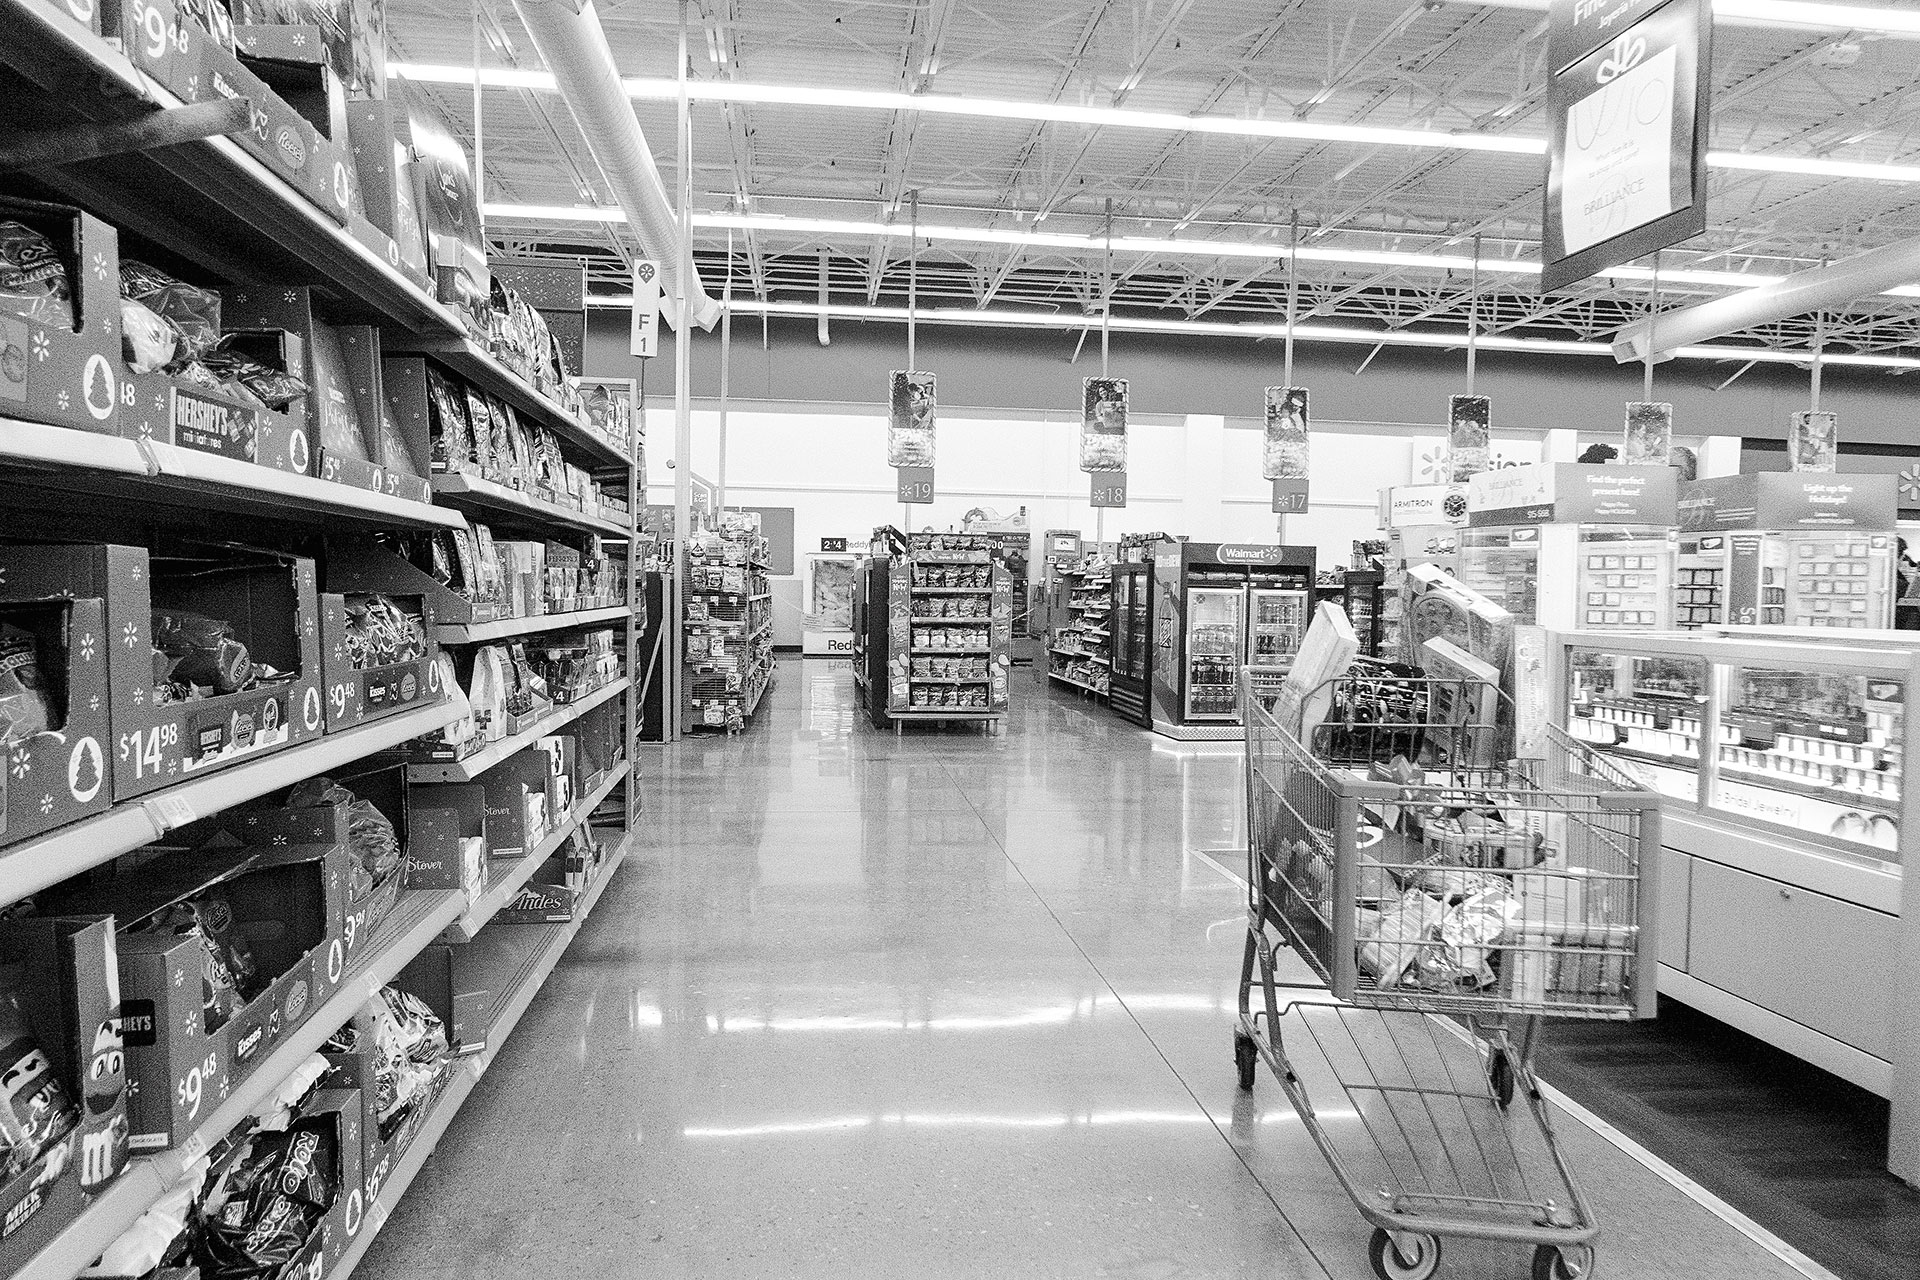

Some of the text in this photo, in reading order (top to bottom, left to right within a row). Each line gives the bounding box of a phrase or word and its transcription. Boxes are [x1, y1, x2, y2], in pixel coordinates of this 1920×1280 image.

[639, 313, 650, 330] F
[640, 337, 646, 352] 1
[176, 395, 228, 436] HERSHEY'S
[914, 483, 931, 498] 19
[1106, 488, 1122, 502] 18
[1289, 494, 1306, 509] 17
[1394, 500, 1433, 508] ARMITRON
[1225, 548, 1265, 559] Walmart
[407, 856, 443, 871] Stover
[508, 893, 563, 911] Andes
